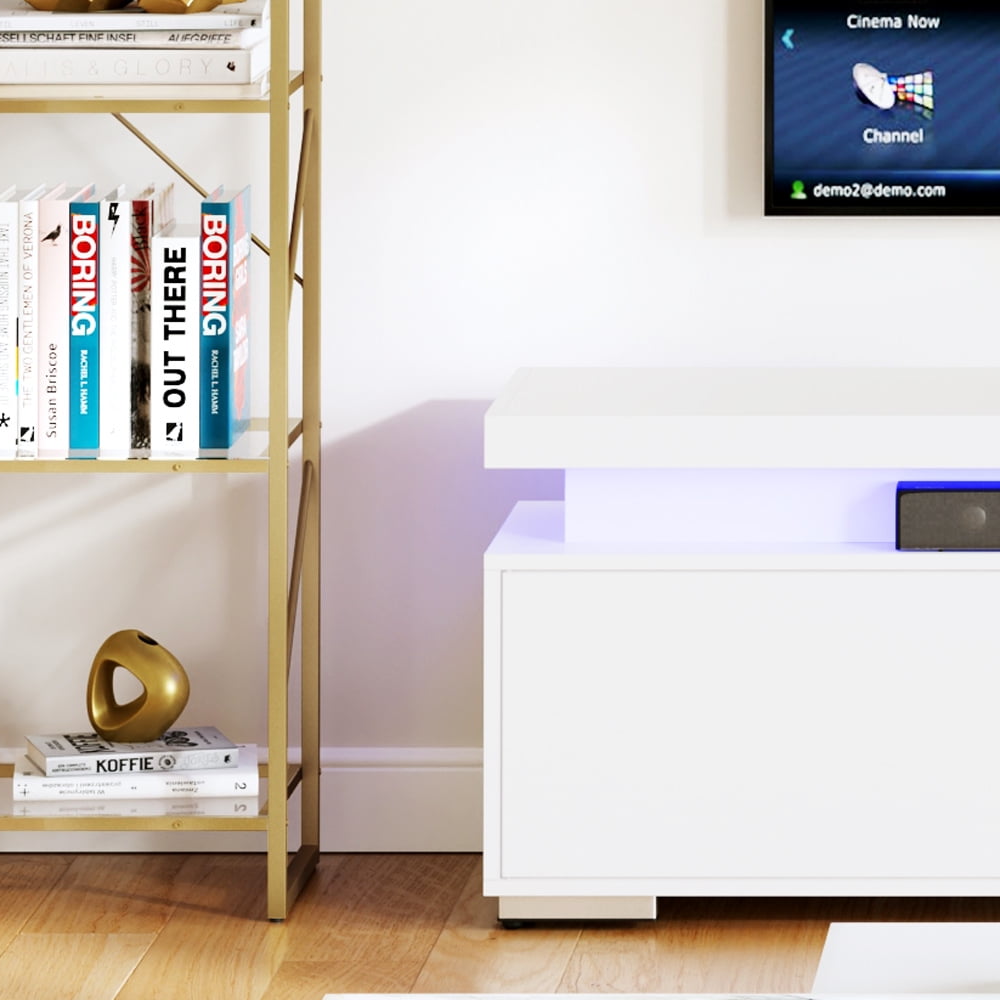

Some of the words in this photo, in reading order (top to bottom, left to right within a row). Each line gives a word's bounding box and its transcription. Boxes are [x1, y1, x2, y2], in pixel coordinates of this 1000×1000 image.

[846, 14, 903, 30] Cinema
[907, 14, 941, 30] Now
[112, 57, 216, 77] GLORY
[862, 128, 924, 144] Channel
[812, 183, 946, 199] demo2@demo.com
[22, 211, 34, 260] VERONA
[22, 265, 34, 280] OF
[71, 213, 97, 337] BORING
[202, 213, 227, 337] BORING
[163, 247, 187, 341] THERE
[22, 285, 34, 355] GENTLEMEN
[22, 358, 34, 383] TWO
[45, 343, 58, 394] Briscoe
[79, 349, 89, 380] RACHEL
[210, 349, 220, 380] RACHEL
[162, 350, 187, 408] OUT
[22, 388, 34, 408] THE
[79, 388, 88, 415] HAMM
[210, 388, 219, 415] HAMM
[46, 397, 58, 438] Susan
[96, 756, 154, 773] KOFFIE
[234, 781, 248, 791] 2
